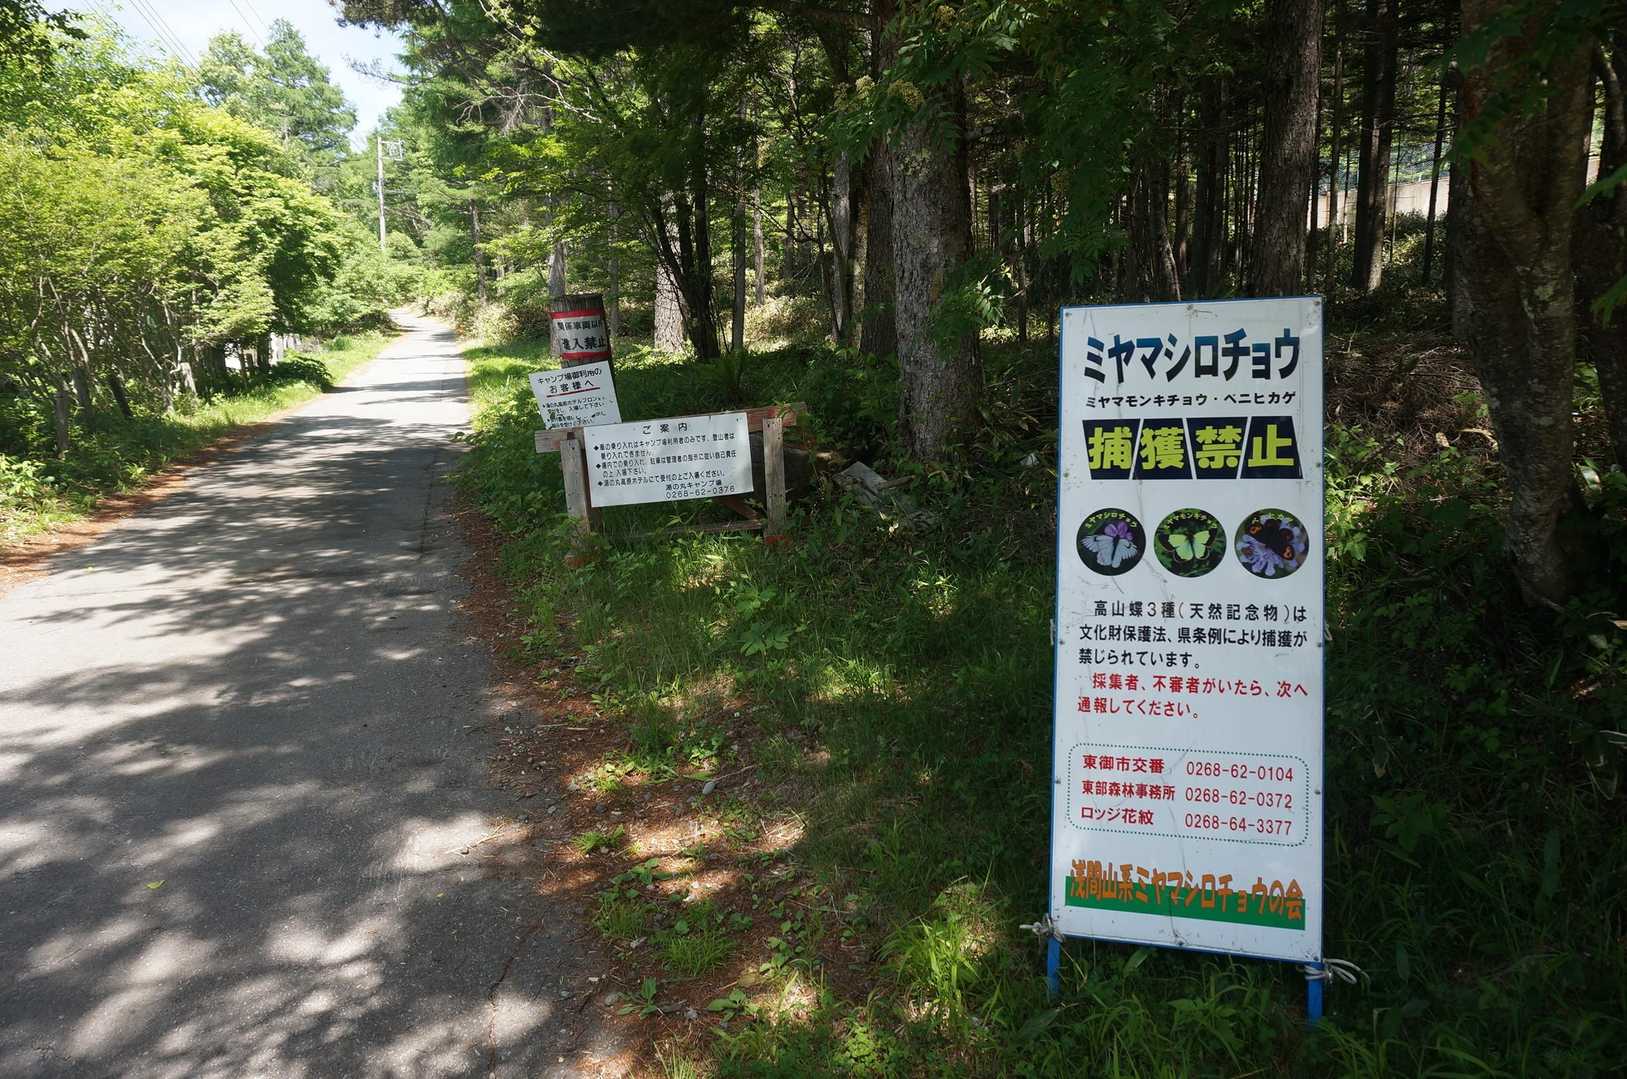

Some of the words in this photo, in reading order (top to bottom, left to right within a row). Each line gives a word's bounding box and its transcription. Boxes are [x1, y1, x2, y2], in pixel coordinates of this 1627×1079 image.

[1084, 328, 1300, 384] ミヤマシロチョウ
[549, 380, 594, 394] お客様へ
[1085, 391, 1296, 409] ミヤマモンキチョウ・ベニヒカゲ
[643, 423, 688, 435] ご案内
[1088, 424, 1294, 470] 捕獲禁止
[666, 485, 735, 499] 0268-62-0376
[1079, 624, 1308, 647] 文化財保護法、県条例により捕獲が
[1079, 648, 1200, 669] 禁じられています。
[1093, 672, 1308, 697] 採集者、不審者がいたら、次へ
[1077, 697, 1199, 719] 通報してください。
[1082, 754, 1165, 774] 東御市交番
[1186, 761, 1293, 782] 0268-62-0104
[1082, 779, 1175, 801] 東部森林事務所
[1185, 787, 1292, 809] 0268-62-0372
[1081, 806, 1154, 825] ロッジ花紋
[1184, 813, 1292, 836] 0268-64-3377
[1070, 859, 1303, 920] 浅間山系ミヤマシロチョウの会
